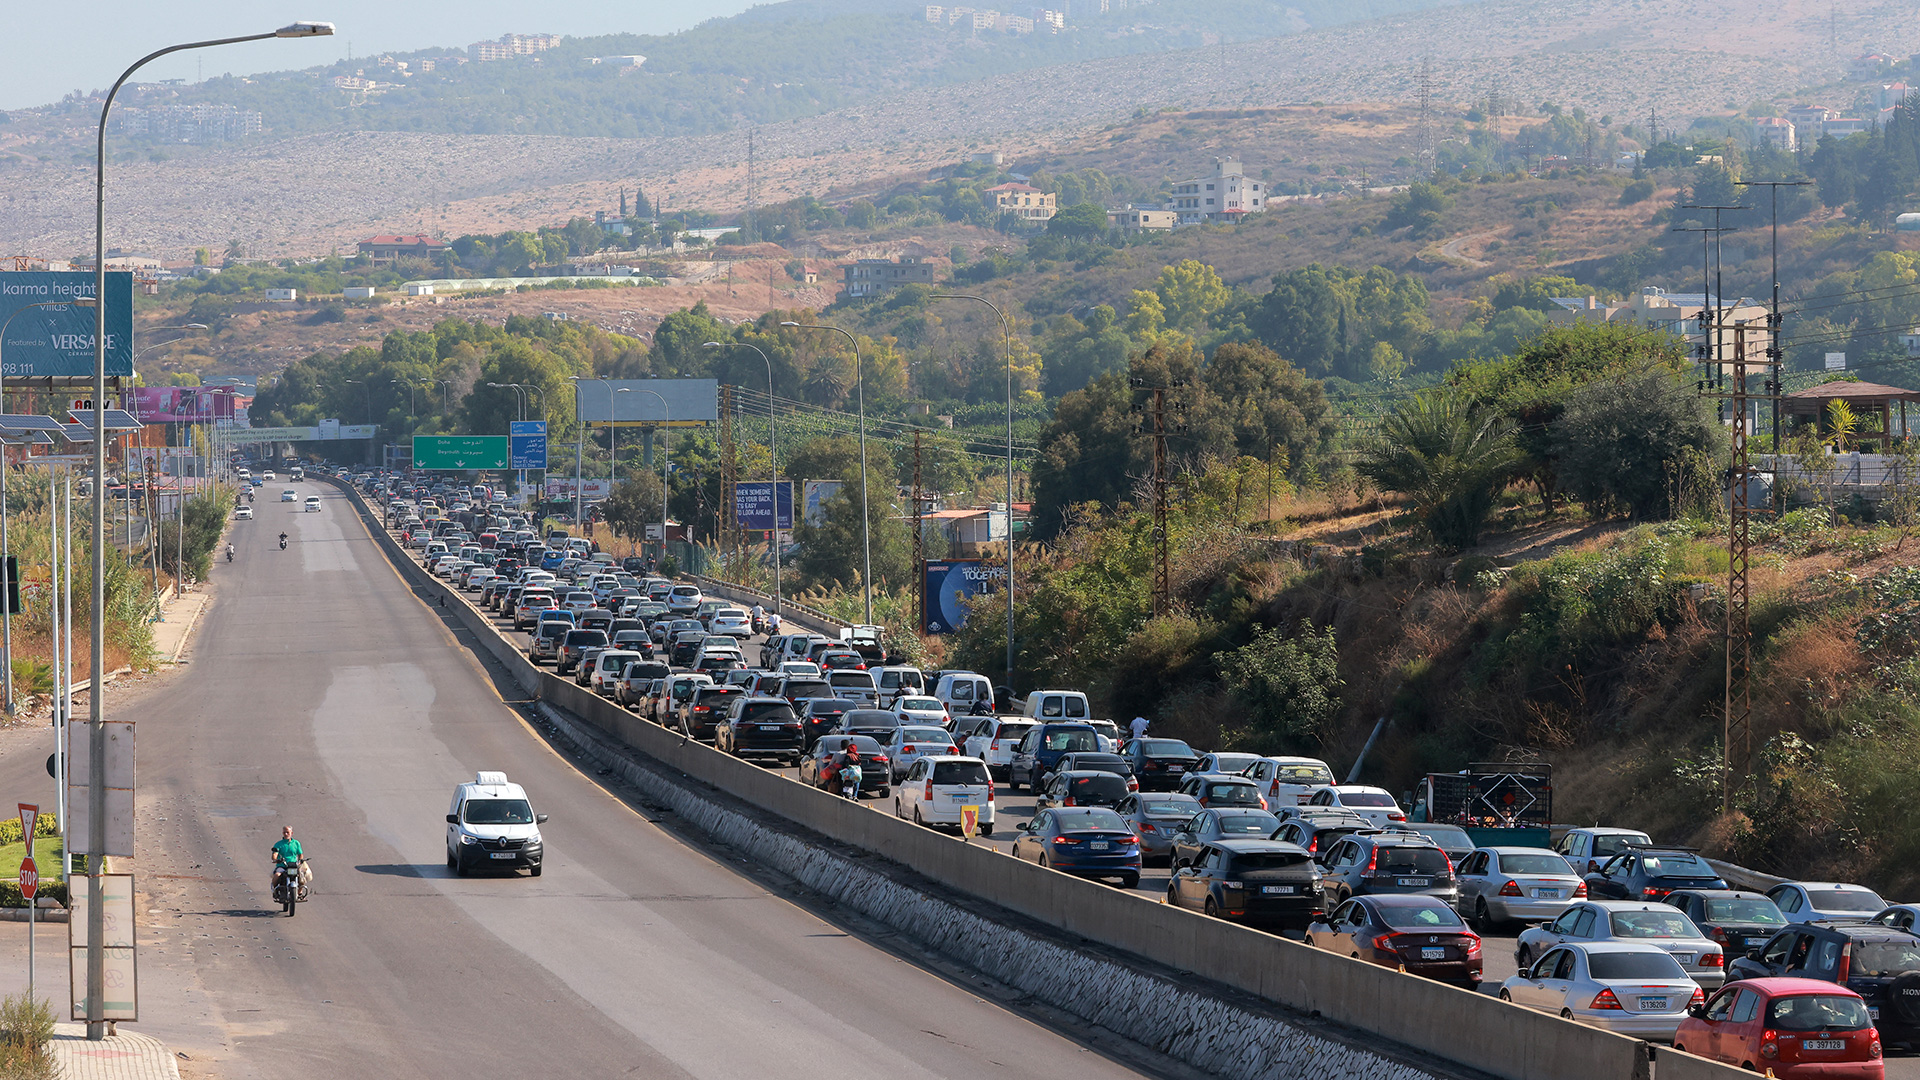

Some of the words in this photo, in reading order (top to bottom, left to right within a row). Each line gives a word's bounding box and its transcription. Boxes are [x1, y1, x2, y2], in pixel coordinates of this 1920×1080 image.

[3, 281, 48, 294] karma
[53, 281, 96, 298] height
[40, 300, 68, 312] villas
[38, 338, 46, 347] by
[2, 363, 16, 373] 98
[20, 364, 34, 373] 111
[963, 572, 1010, 580] TOGETH
[20, 870, 36, 886] STOP
